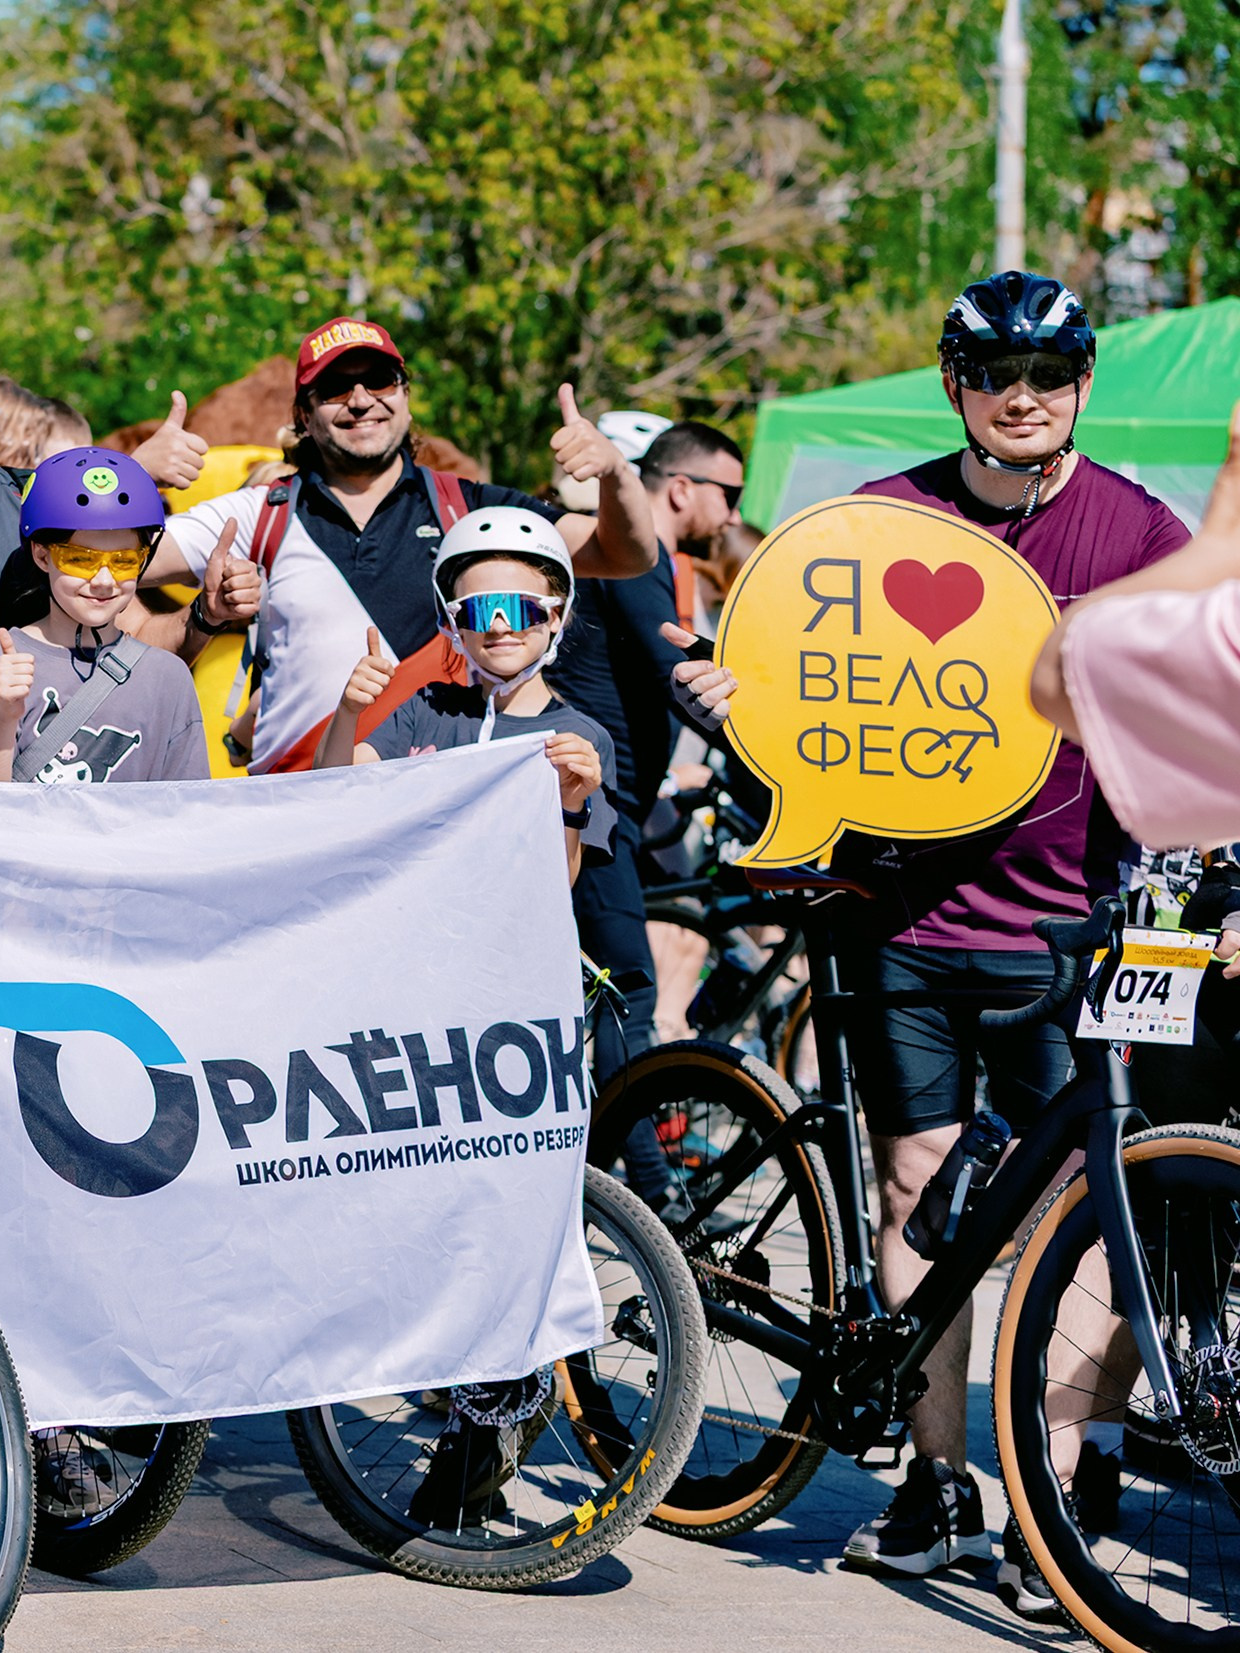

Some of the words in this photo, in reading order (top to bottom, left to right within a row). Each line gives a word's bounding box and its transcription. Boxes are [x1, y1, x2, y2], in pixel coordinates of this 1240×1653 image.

[802, 557, 862, 636] Я
[1114, 968, 1173, 1006] 074
[236, 1155, 331, 1186] ШКОЛА
[336, 1131, 530, 1175] ОЛИМПИЙСКОГО
[551, 1448, 656, 1549] WANDA
